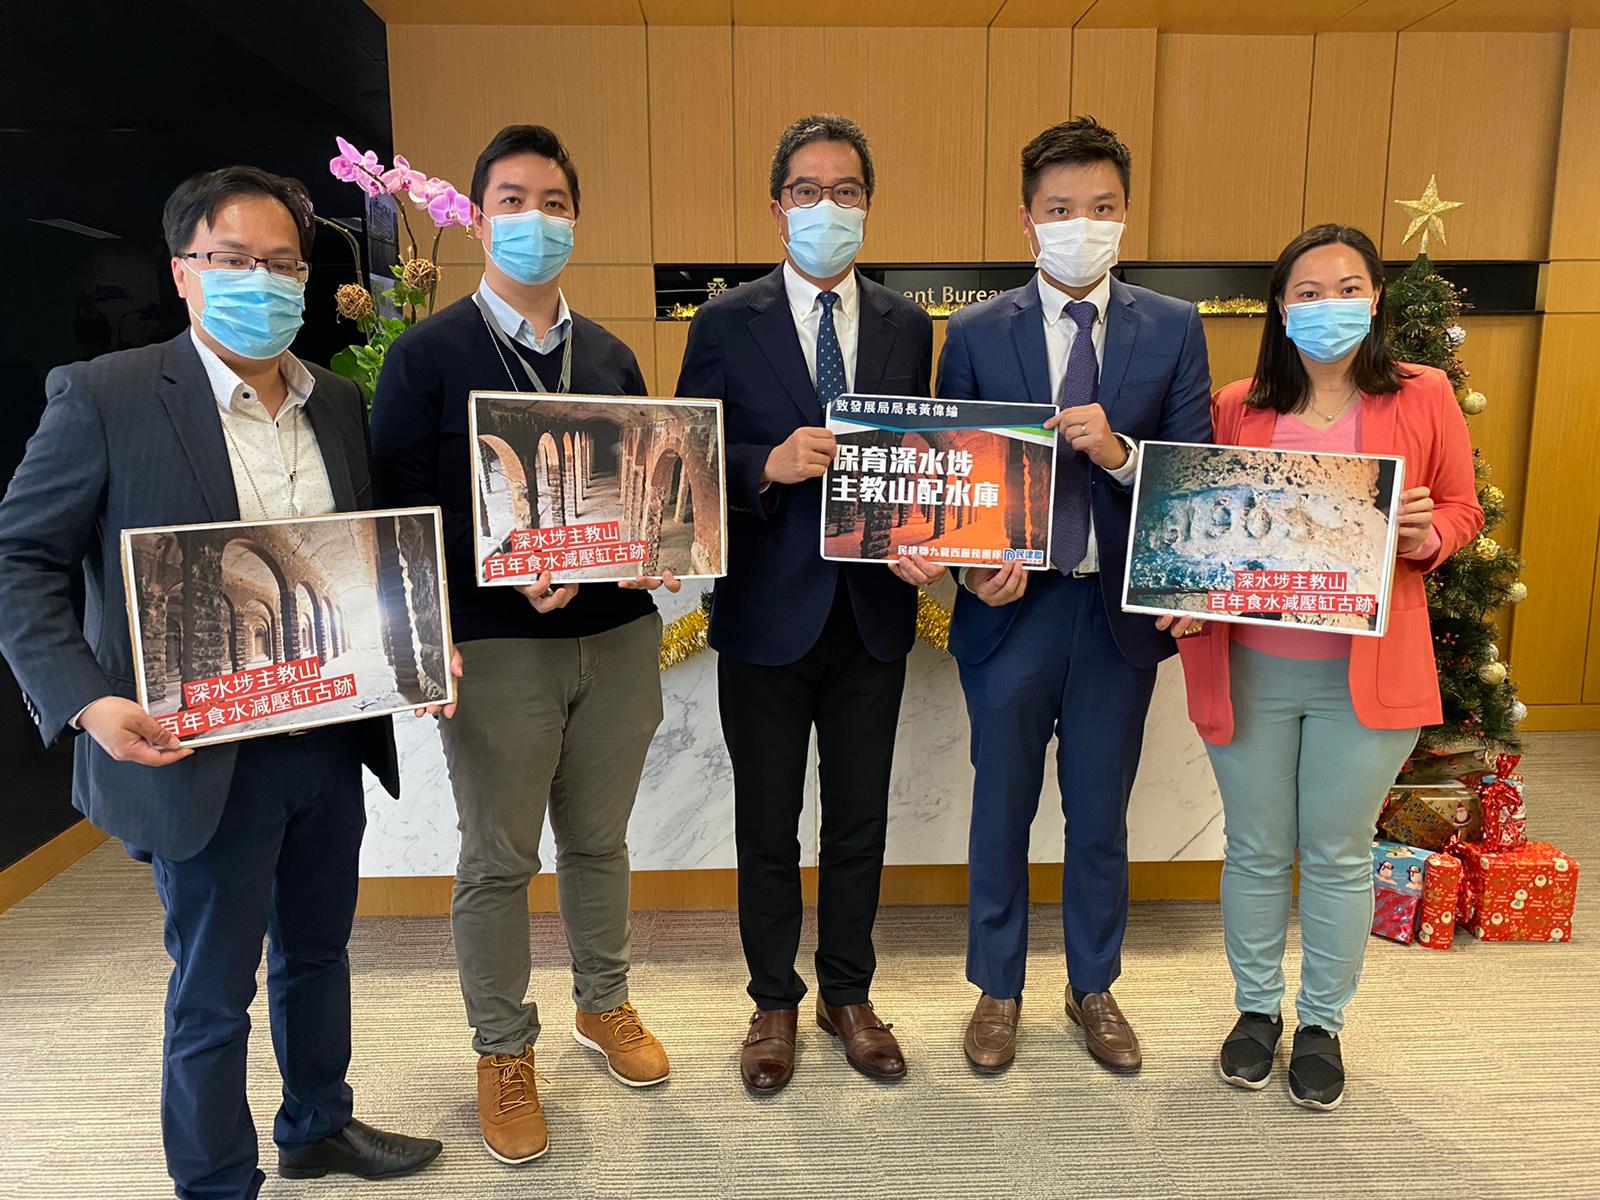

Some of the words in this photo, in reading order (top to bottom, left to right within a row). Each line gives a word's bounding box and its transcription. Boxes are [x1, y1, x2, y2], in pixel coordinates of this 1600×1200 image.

[897, 288, 934, 303] ent
[942, 286, 1004, 303] Burea
[836, 400, 959, 418] 致發展局局長黃偉綸
[834, 444, 973, 477] 保育深水埗
[831, 475, 999, 508] 主教山配水庫
[513, 523, 619, 549] 深水埗主教山
[488, 543, 646, 577] 百年食水減壓缸古跡
[1237, 572, 1346, 590] 深水埗主教山
[1210, 594, 1373, 611] 百年食水減壓缸古跡
[187, 660, 320, 704] 深水埗主教山
[157, 677, 354, 736] 百年食水減壓缸古跡
